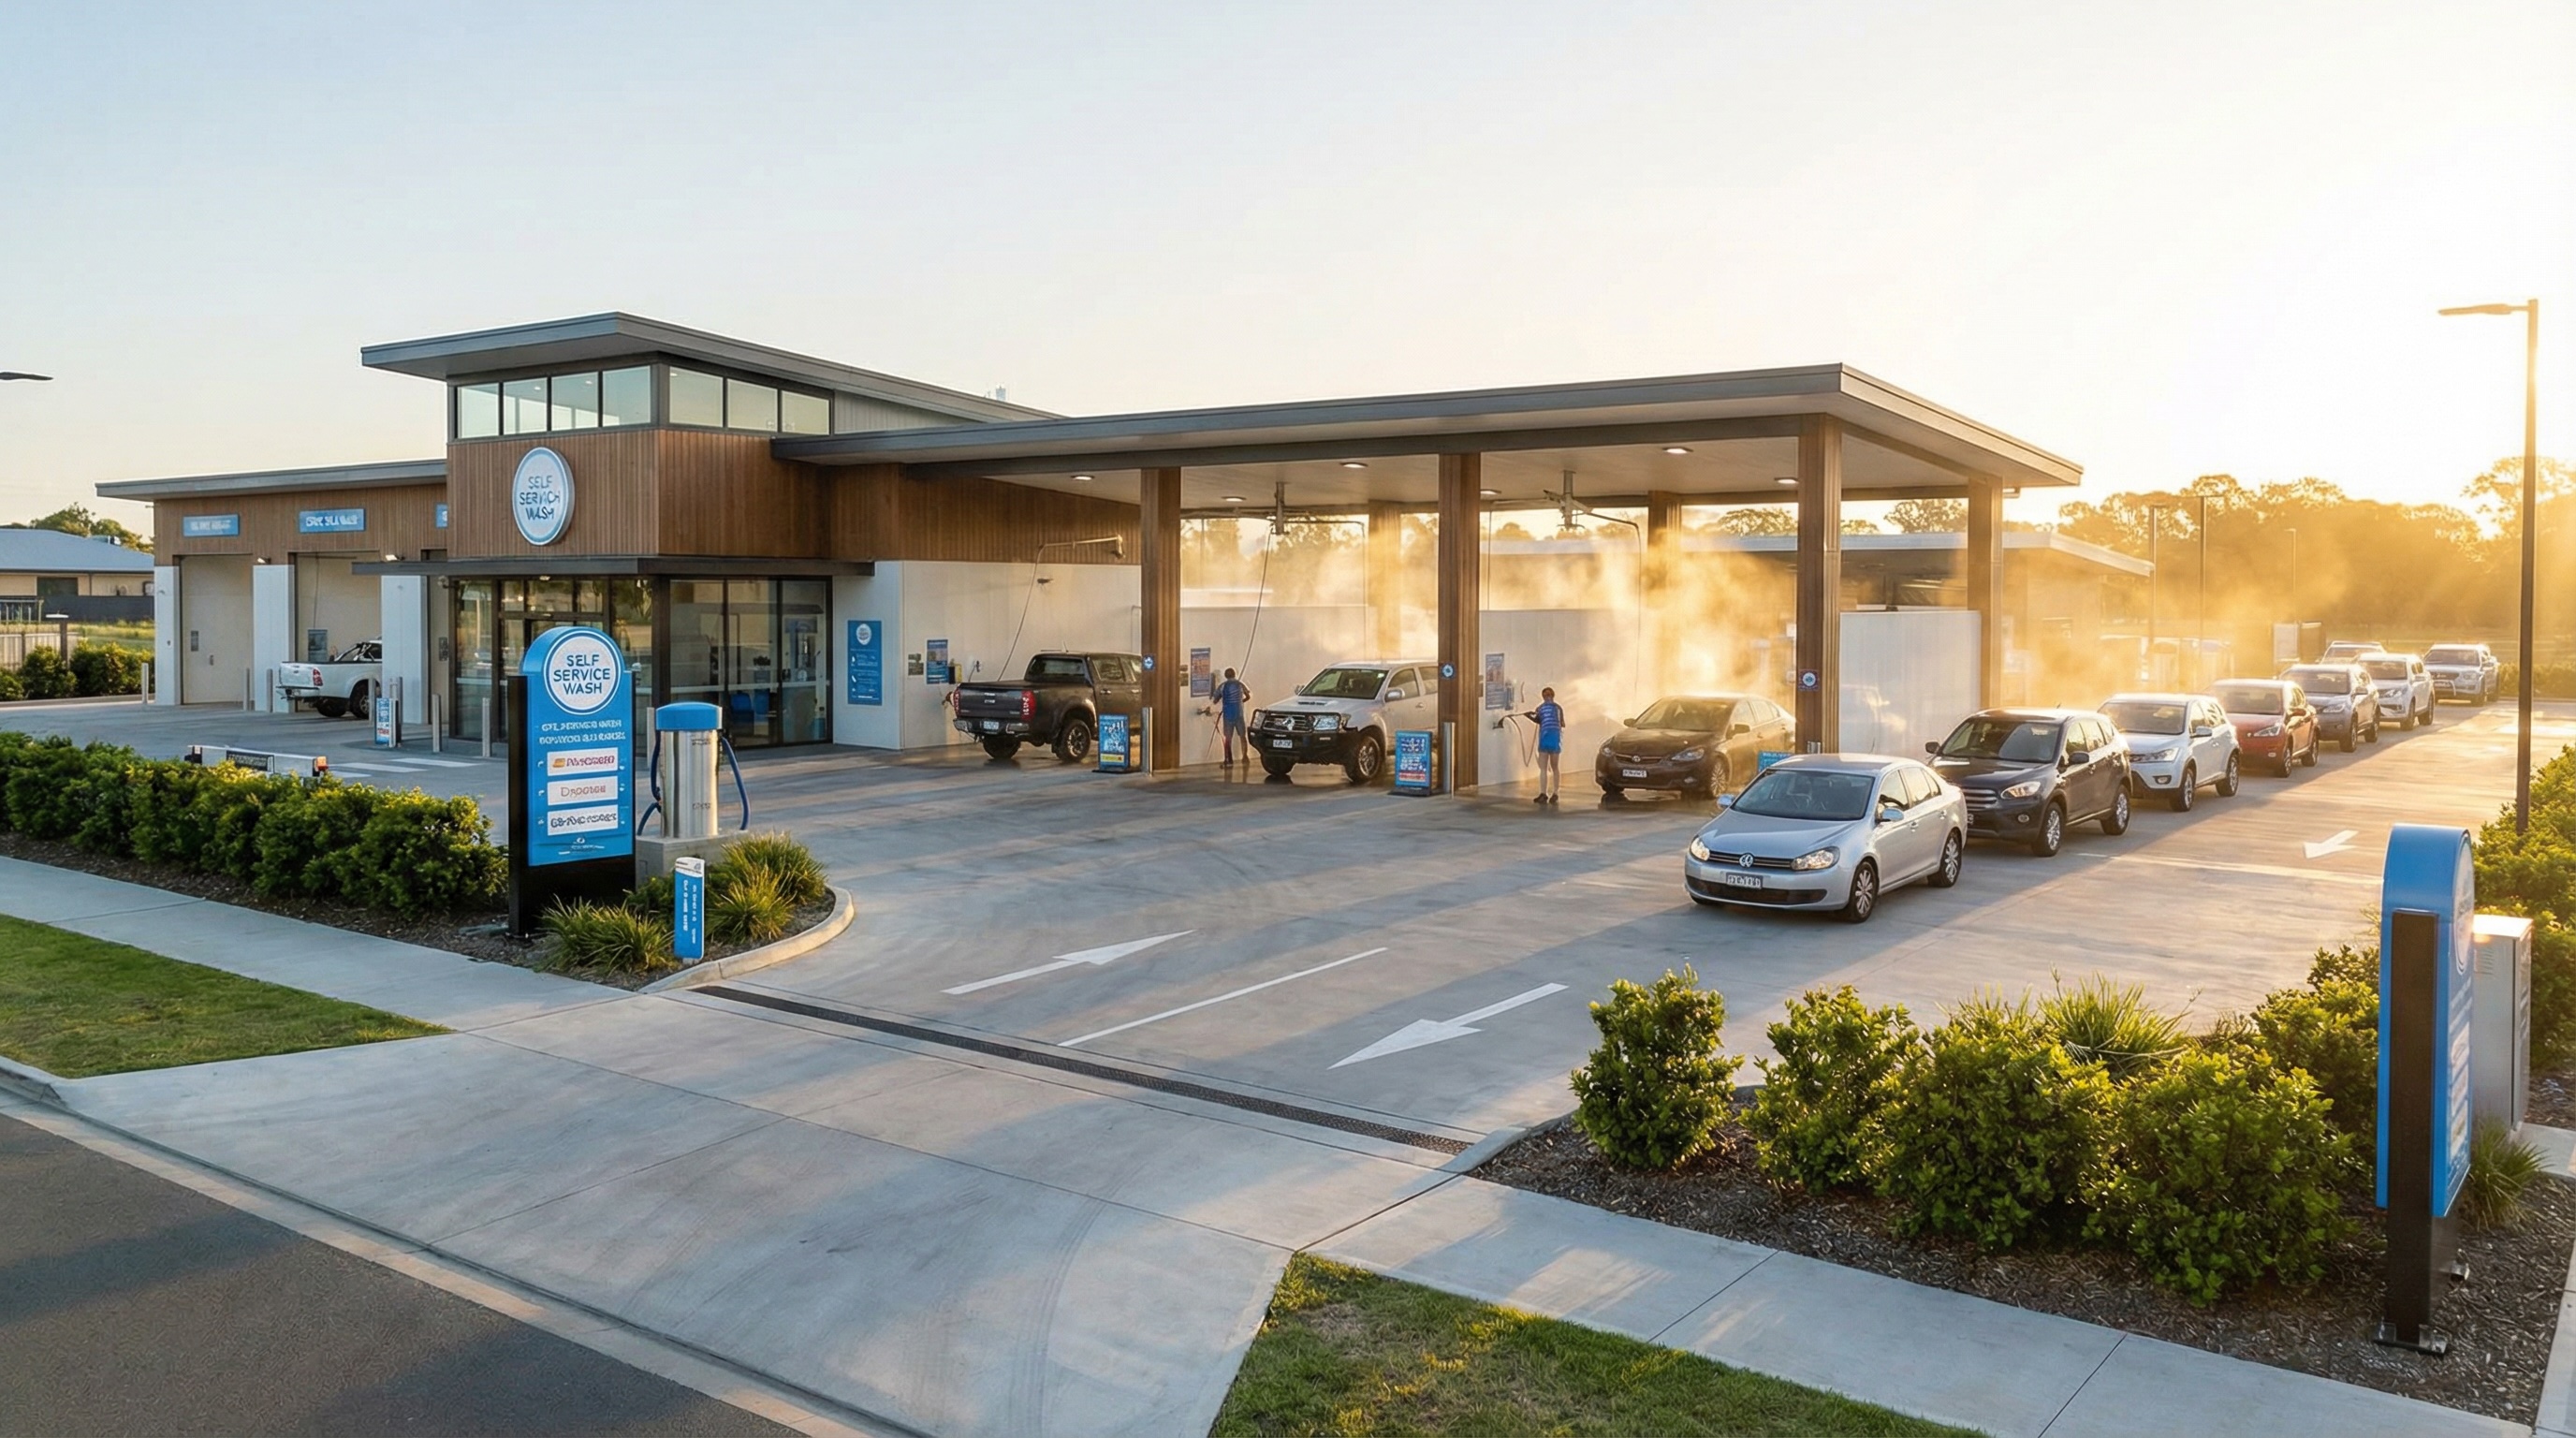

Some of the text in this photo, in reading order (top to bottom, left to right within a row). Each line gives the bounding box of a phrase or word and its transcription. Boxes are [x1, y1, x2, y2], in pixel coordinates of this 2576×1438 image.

[528, 475, 553, 490] SELF
[566, 654, 600, 668] SELF
[553, 668, 610, 682] SERVICE
[563, 682, 603, 696] WASH
